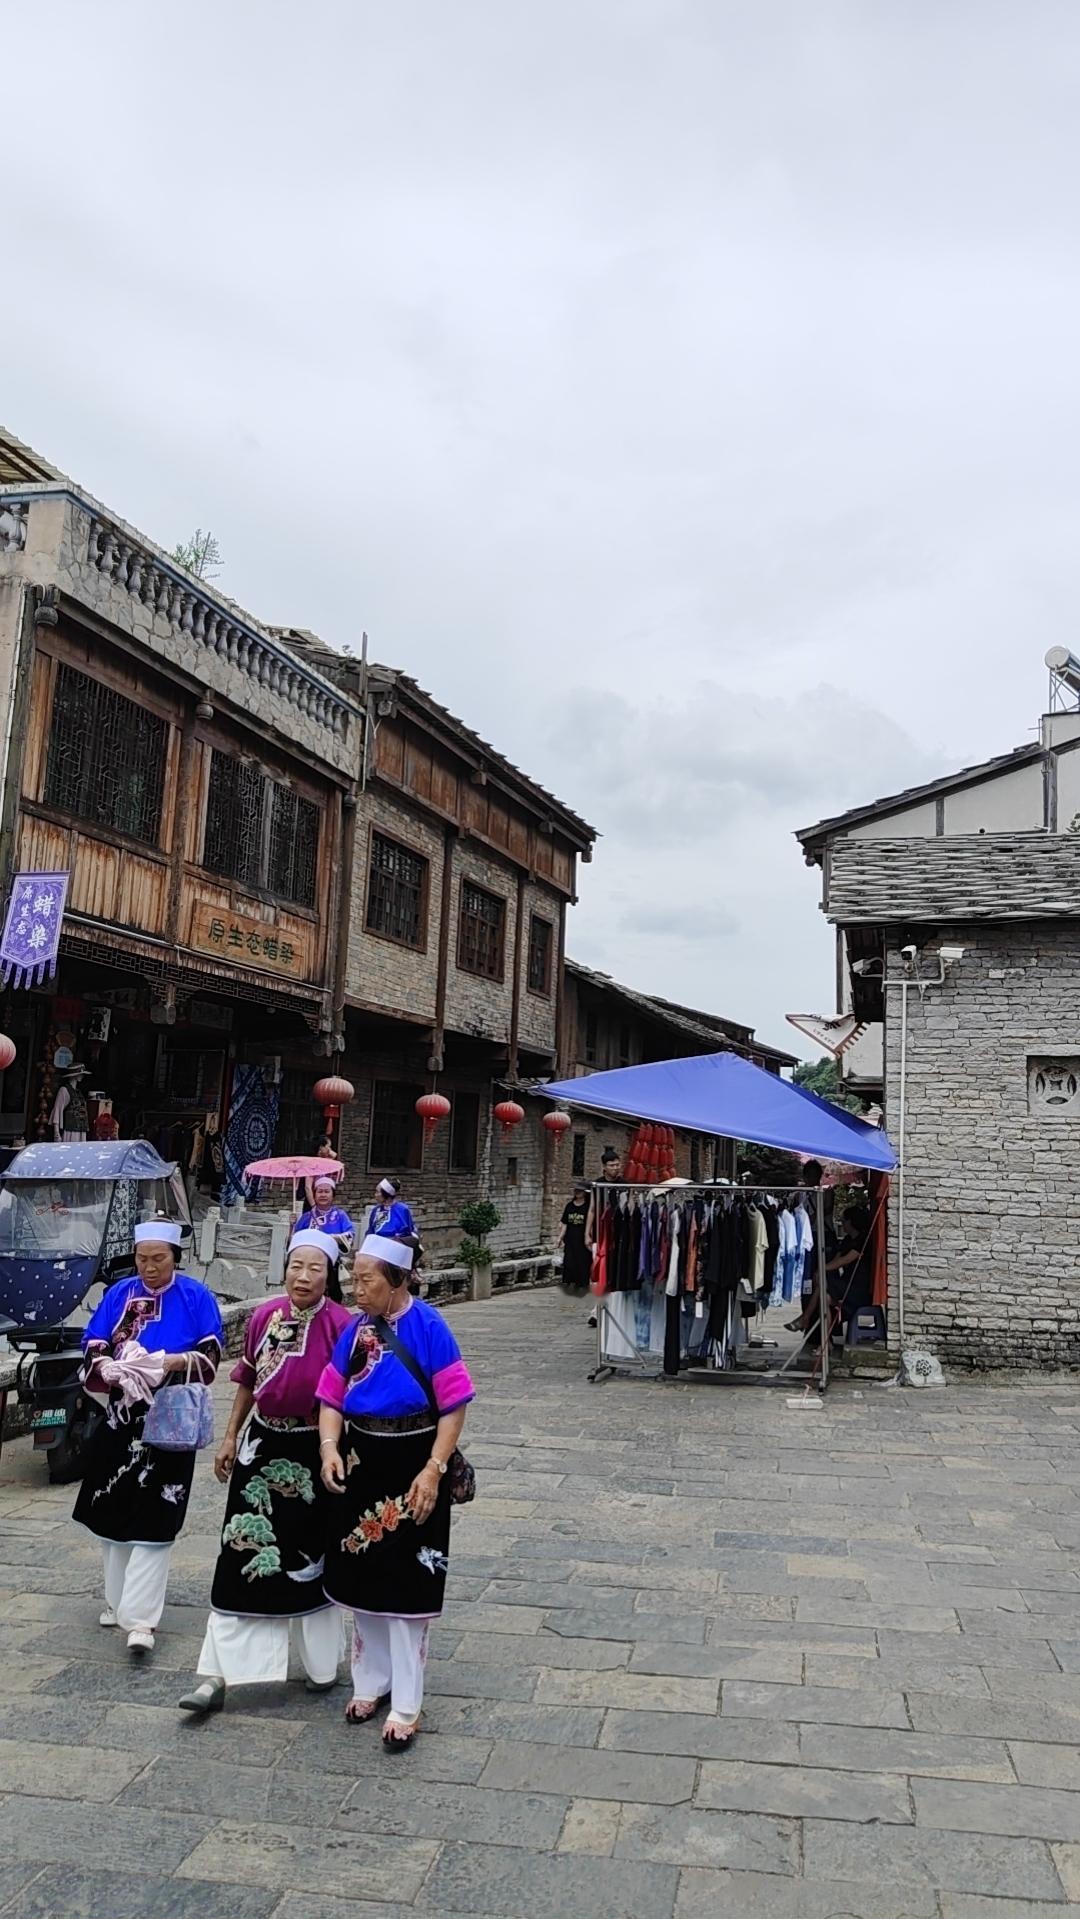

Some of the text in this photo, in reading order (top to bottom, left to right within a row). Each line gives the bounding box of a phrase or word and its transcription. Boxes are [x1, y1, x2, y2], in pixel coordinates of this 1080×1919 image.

[27, 893, 55, 949] 蜡染
[208, 917, 294, 964] 原生态蜡染
